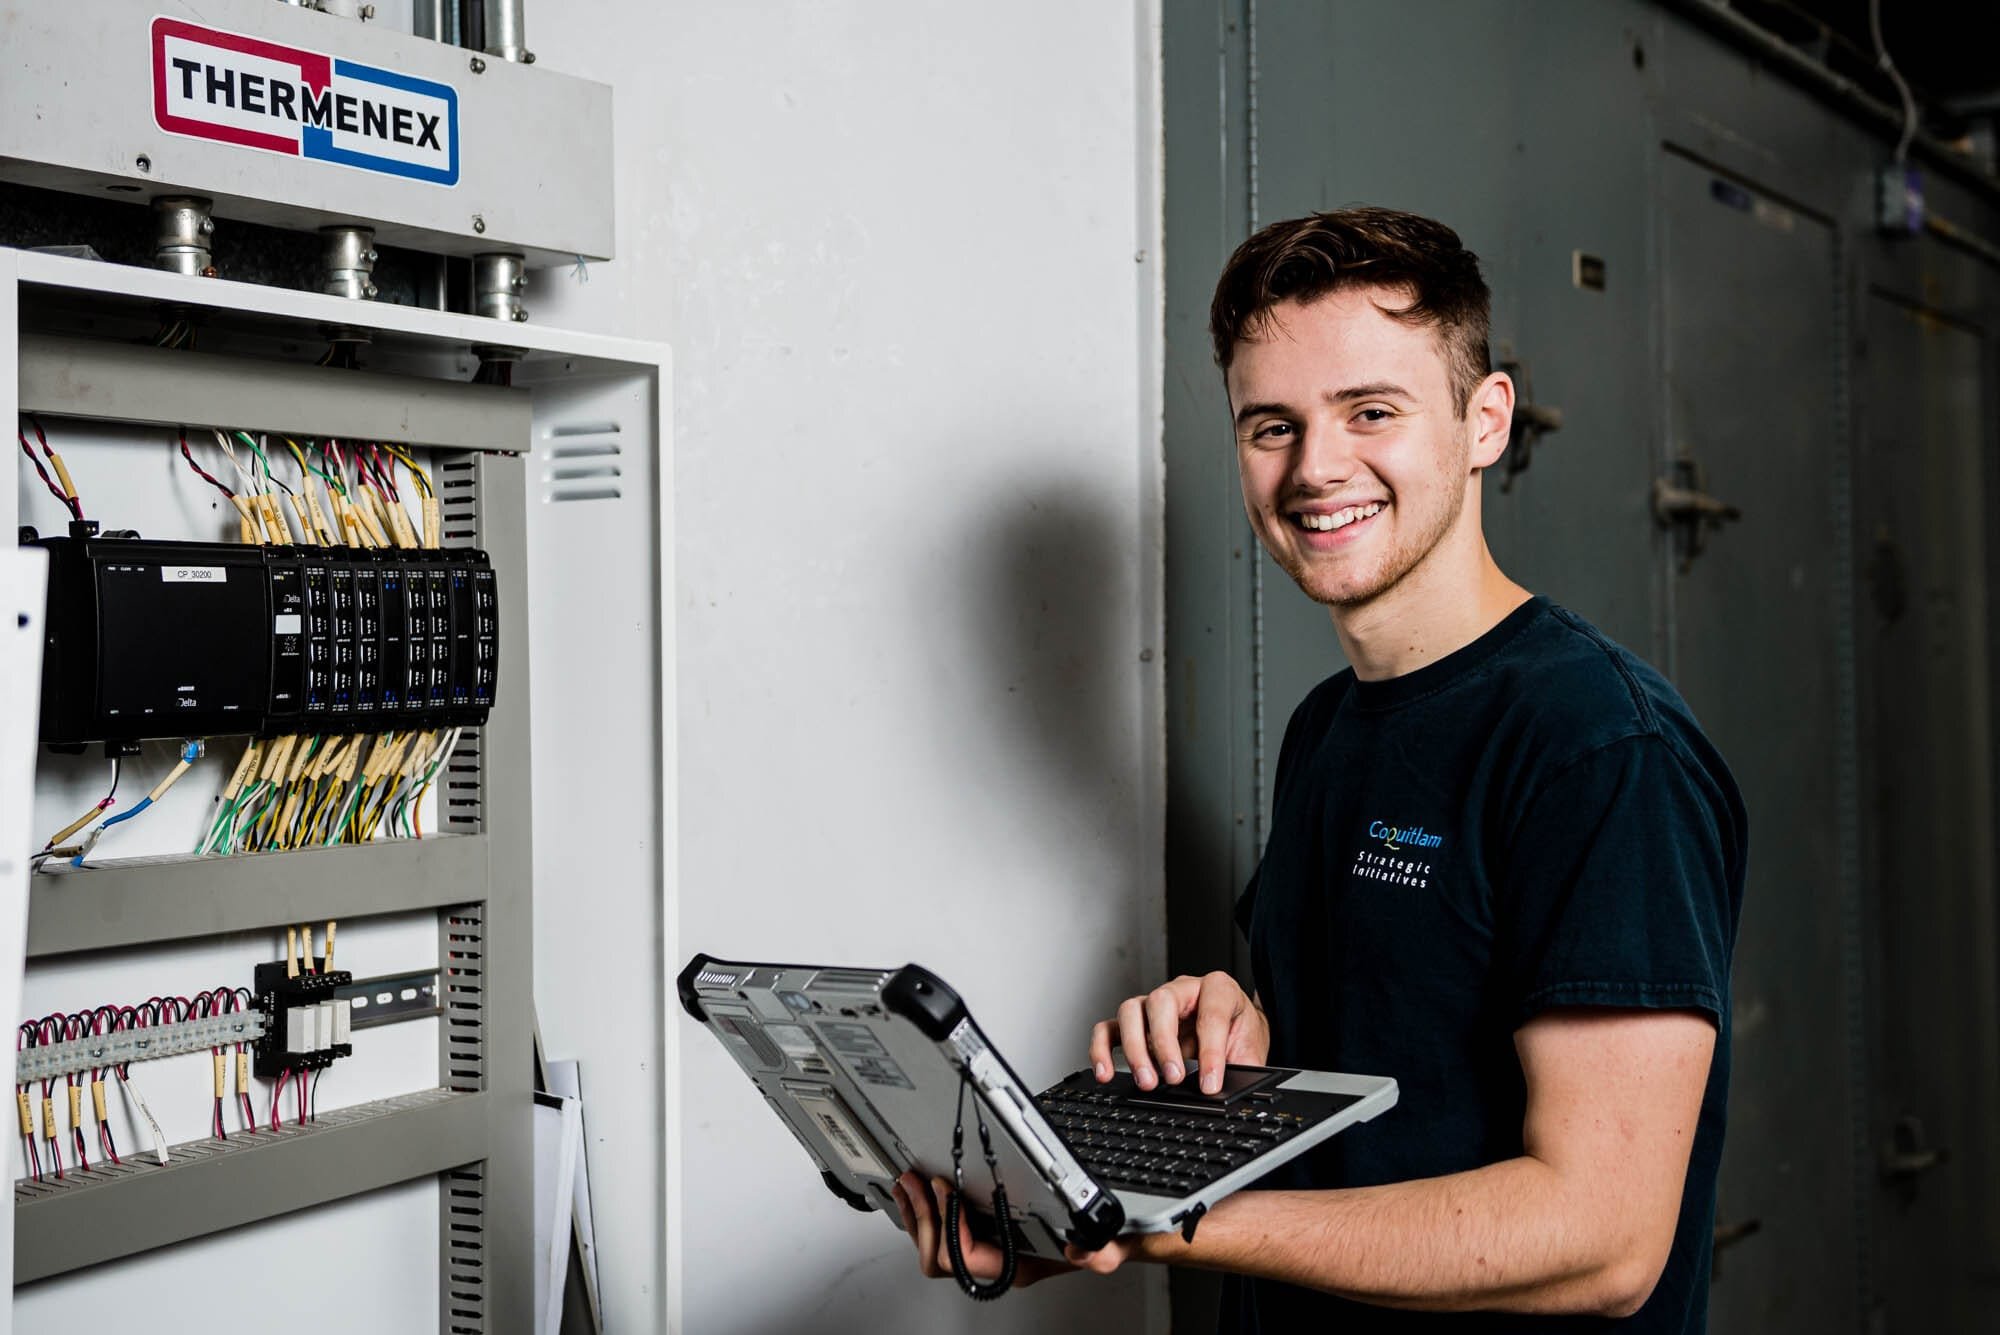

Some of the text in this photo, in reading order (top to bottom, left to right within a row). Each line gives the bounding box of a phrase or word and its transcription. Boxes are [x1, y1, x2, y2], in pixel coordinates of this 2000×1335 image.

[172, 57, 442, 151] THERMENEX
[1357, 851, 1431, 874] Strategic
[1352, 864, 1427, 888] Initiatives
